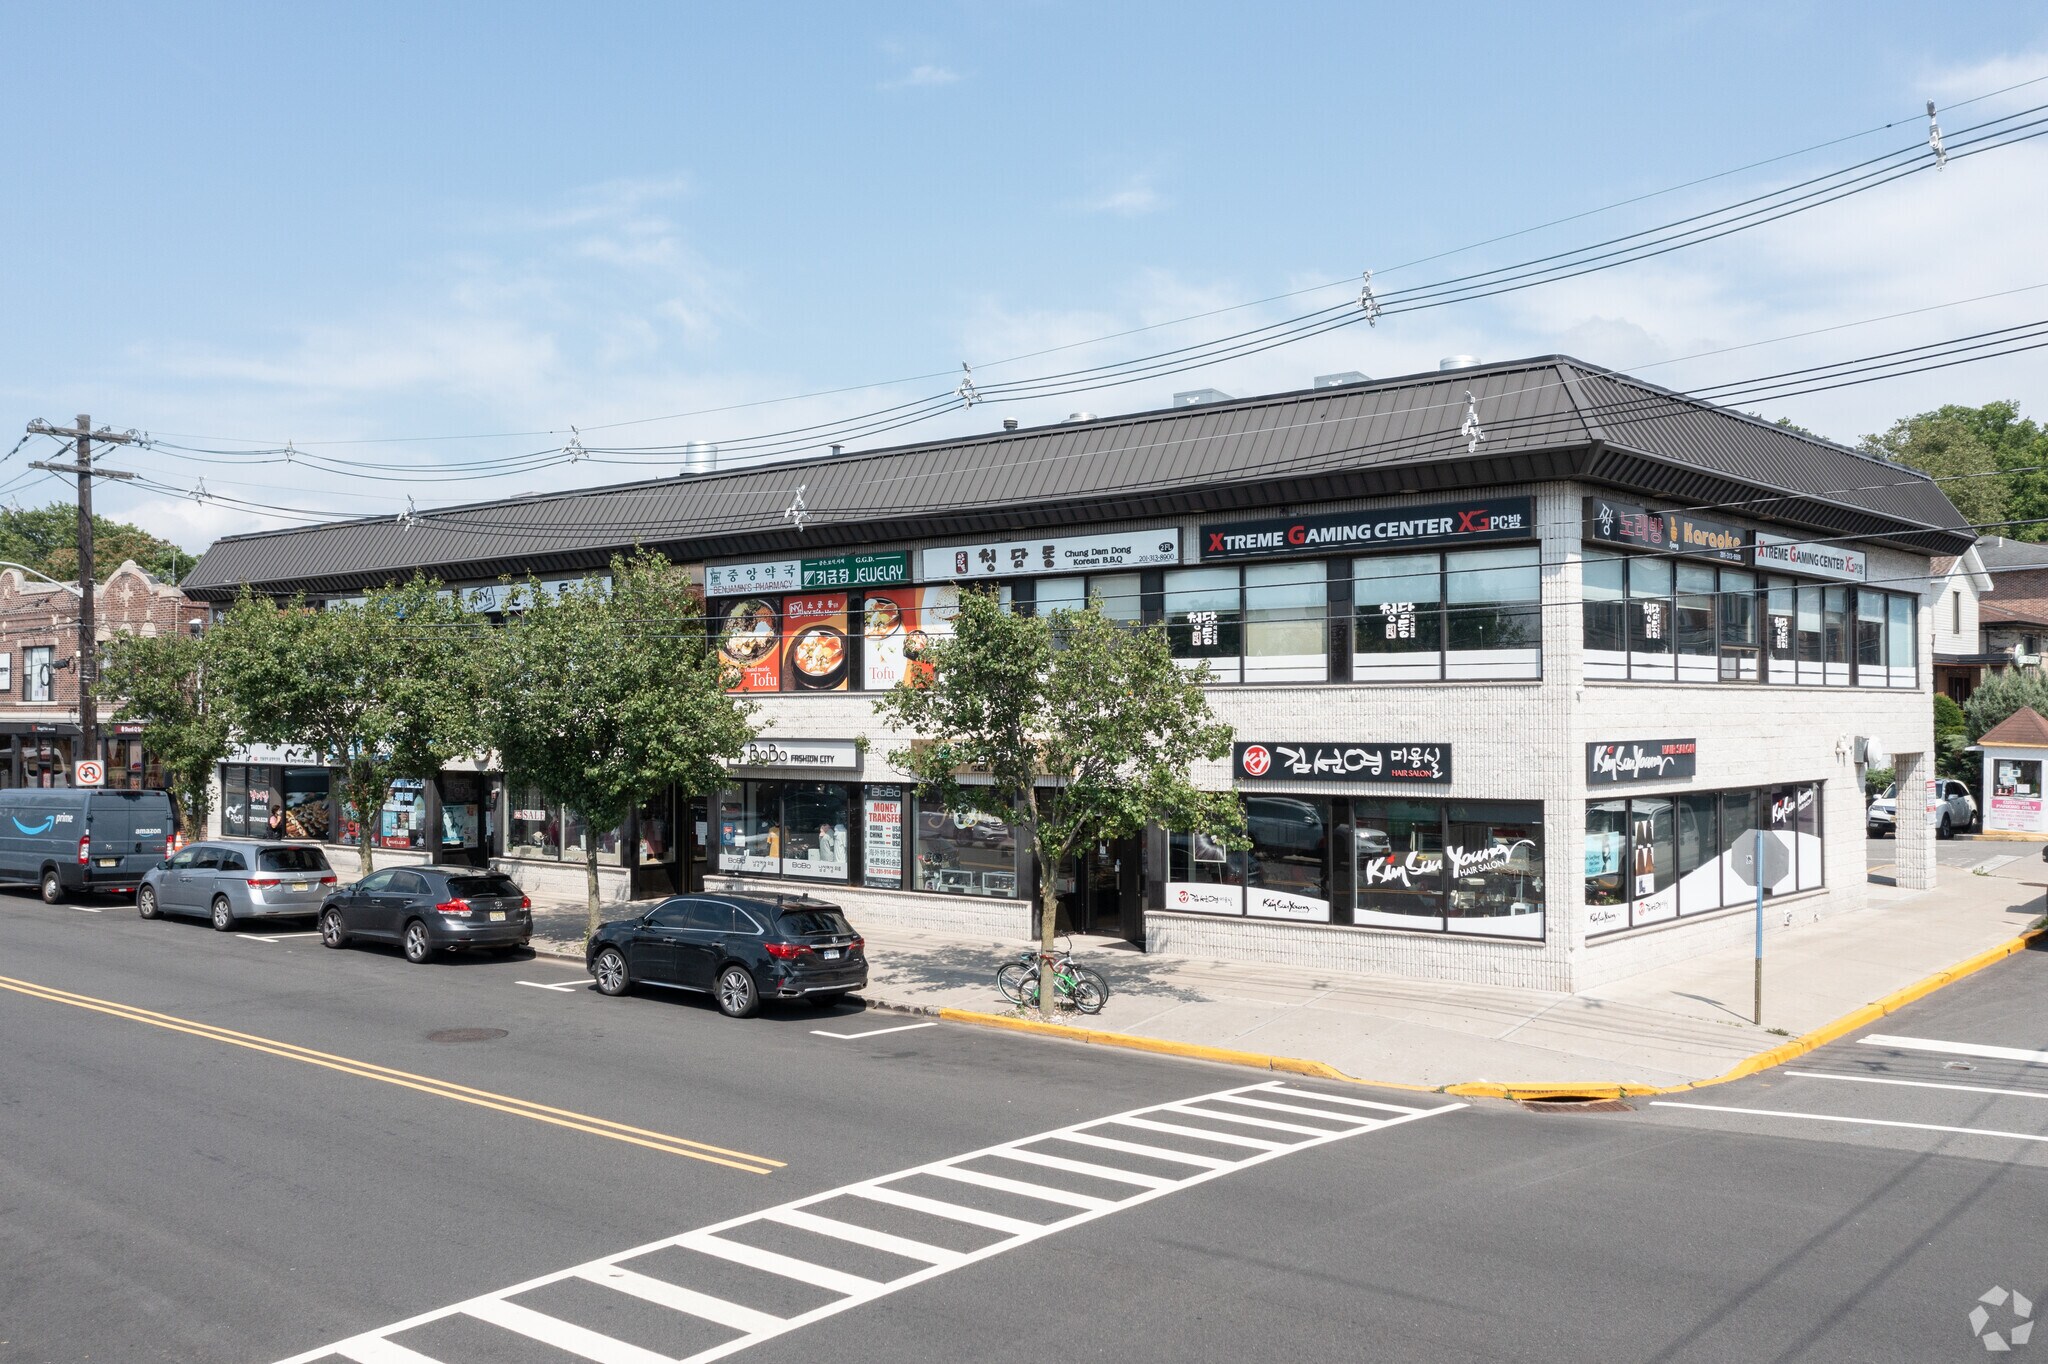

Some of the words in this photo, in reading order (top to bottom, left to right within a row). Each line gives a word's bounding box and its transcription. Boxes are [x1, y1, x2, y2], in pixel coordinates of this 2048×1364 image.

[1208, 532, 1284, 551] XTREME
[1288, 524, 1371, 545] GAMING
[1374, 517, 1453, 538] CENTER
[1490, 513, 1521, 529] PC방
[1619, 511, 1664, 543] 노래방
[1684, 522, 1741, 551] Karaoke
[978, 545, 1055, 572] 청담동
[1065, 549, 1089, 559] Chung
[1091, 547, 1110, 557] Dam
[1112, 546, 1132, 556] Dong
[1073, 556, 1100, 566] Korean
[1102, 555, 1123, 564] B.B.Q
[1758, 540, 1788, 561] XTREME
[1790, 546, 1819, 566] GAMING
[1820, 555, 1844, 571] CENTER
[727, 564, 795, 582] 중앙약국
[854, 564, 903, 583] JEWELRY
[713, 583, 752, 594] BENJAMIN'S
[755, 580, 793, 592] PHARMACY
[751, 672, 777, 686] Tofu
[869, 666, 895, 680] Tofu
[749, 744, 787, 763] BoBo
[790, 755, 818, 763] FASHION
[820, 755, 835, 763] CITY
[1276, 746, 1383, 775] 김선영
[1391, 747, 1443, 778] 미용실
[873, 803, 897, 812] MONEY
[55, 812, 74, 824] prime
[1366, 854, 1411, 887] Kim
[1405, 851, 1443, 875] Sun
[1446, 840, 1536, 878] Young
[1459, 866, 1478, 877] HAIR
[1478, 859, 1505, 873] SALON
